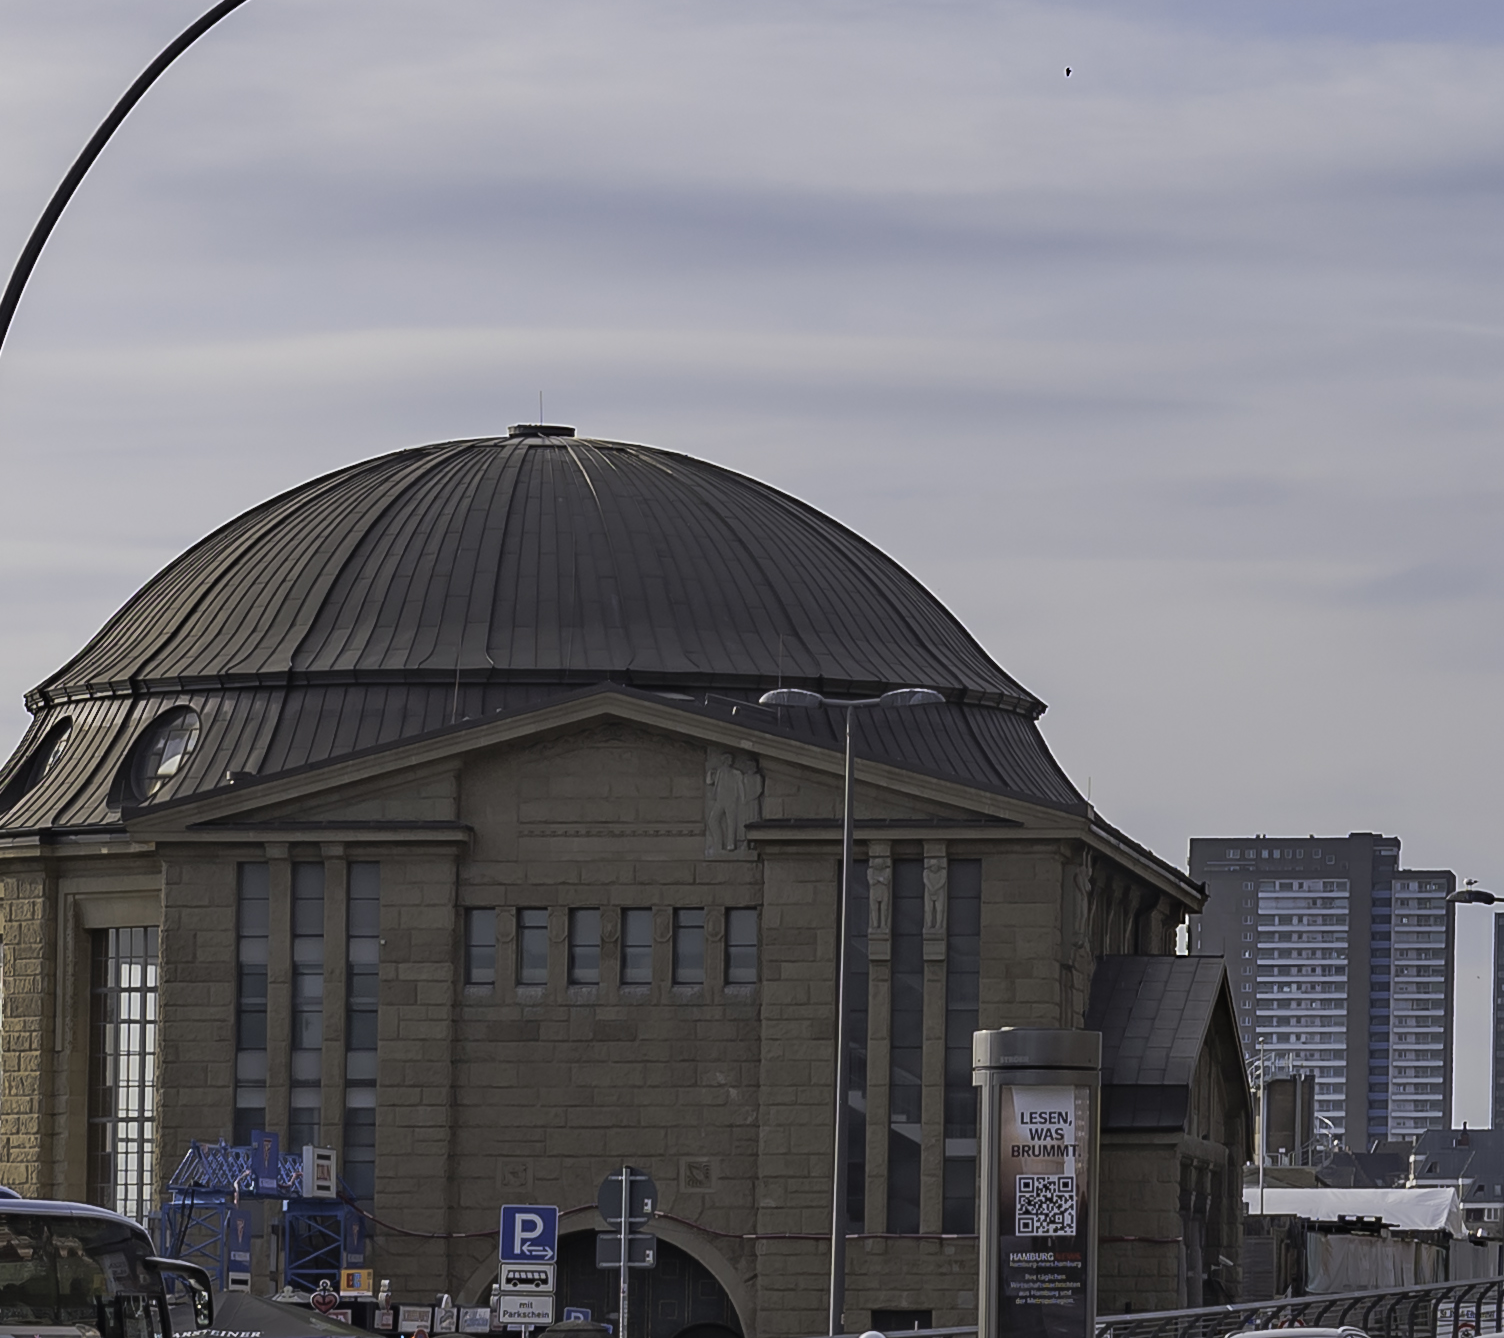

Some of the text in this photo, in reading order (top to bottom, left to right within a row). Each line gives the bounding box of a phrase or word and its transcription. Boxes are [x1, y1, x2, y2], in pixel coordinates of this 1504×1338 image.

[1020, 1111, 1072, 1126] LESEN,
[1029, 1127, 1064, 1141] WAS
[1011, 1144, 1081, 1158] BRUMMT.
[514, 1213, 544, 1254] P
[1009, 1252, 1054, 1261] HAMBURG
[502, 1310, 550, 1320] Parkschein
